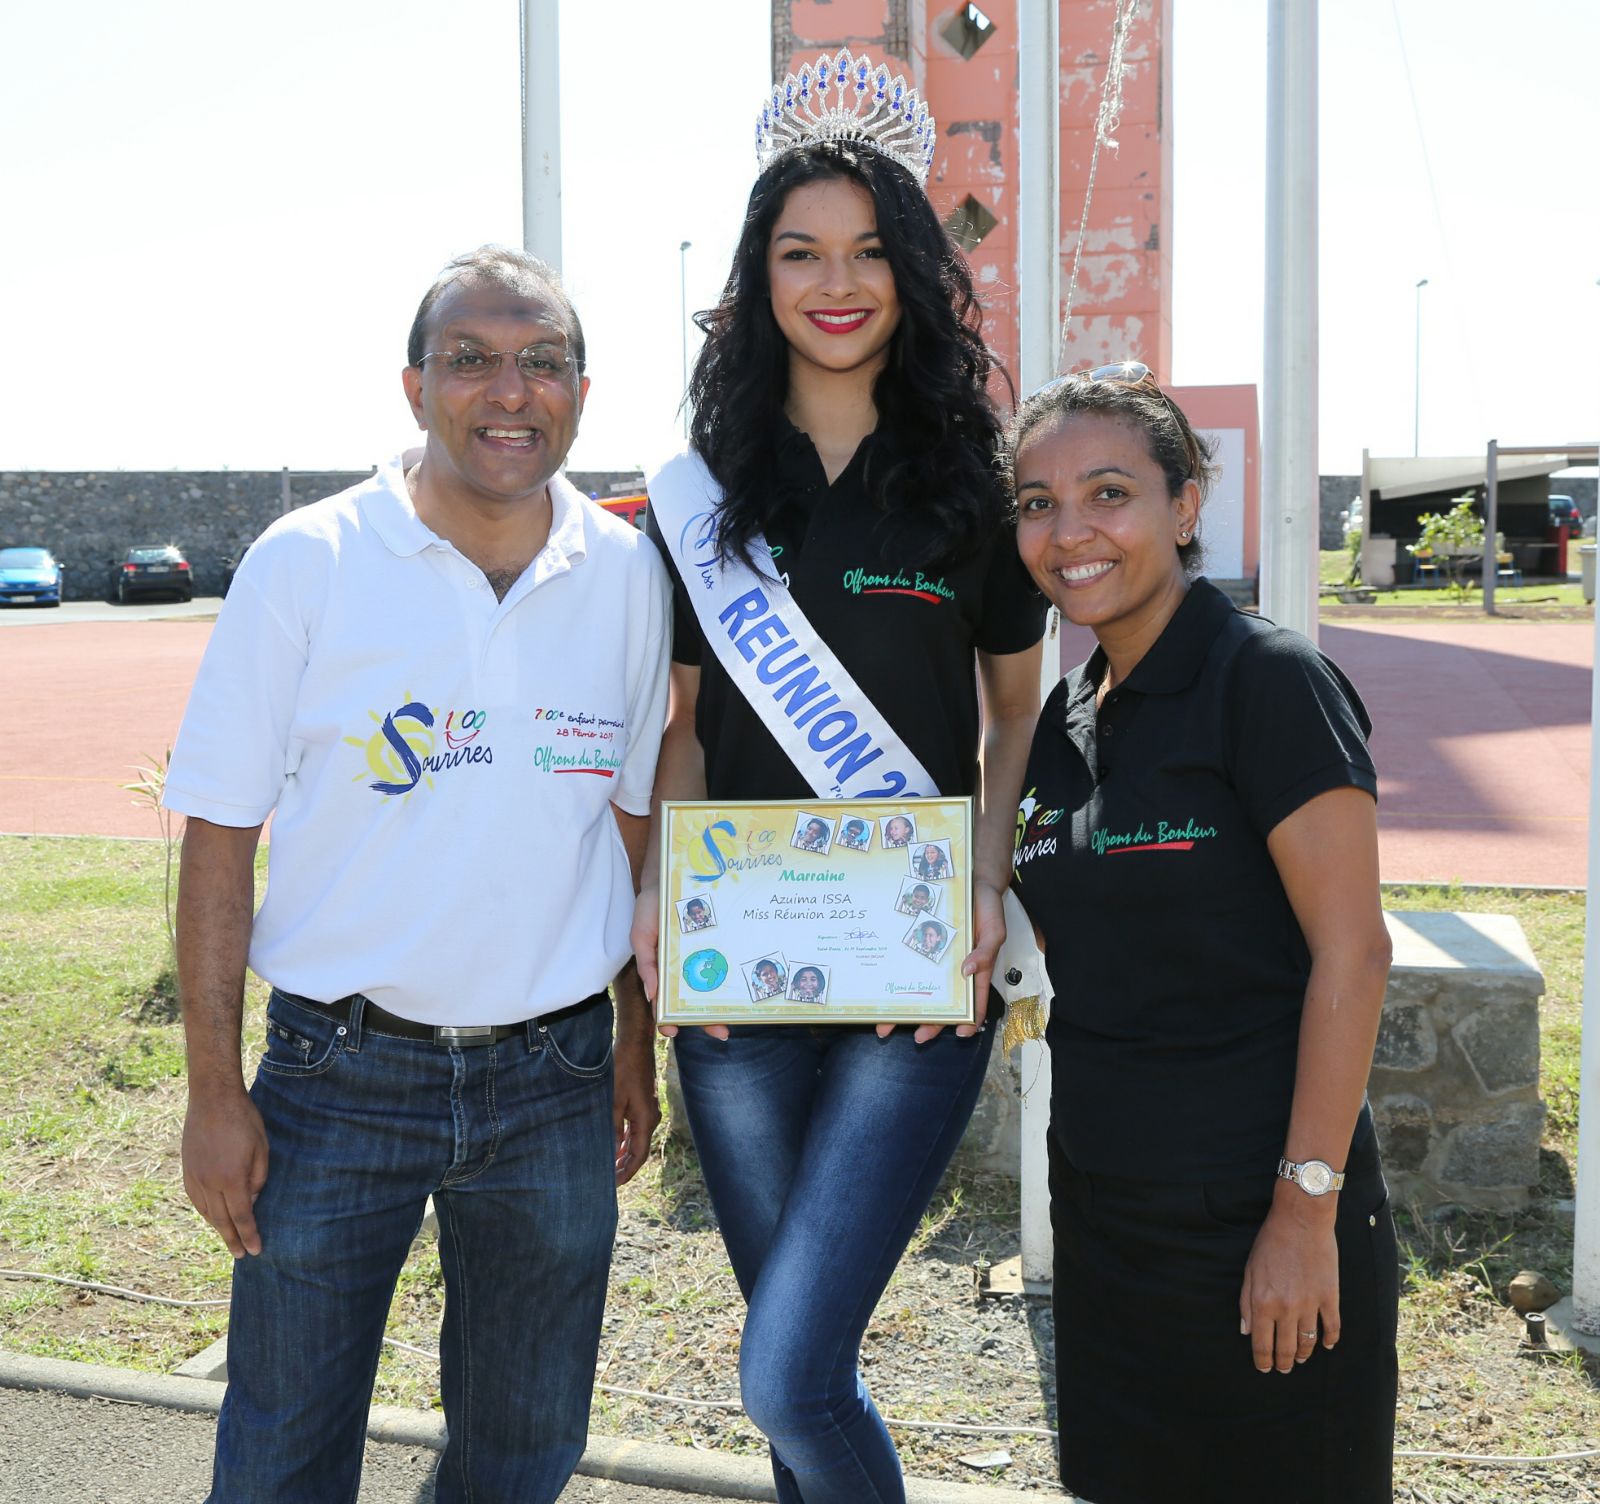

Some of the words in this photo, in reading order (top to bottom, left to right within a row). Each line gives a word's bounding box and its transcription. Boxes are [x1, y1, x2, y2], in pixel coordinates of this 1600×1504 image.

[843, 568, 890, 594] Offrons
[891, 568, 911, 587] du
[914, 572, 955, 601] Bonheur
[718, 587, 884, 785] REUNION
[853, 770, 921, 798] 2
[556, 728, 569, 737] 28
[567, 712, 595, 726] enfant
[368, 702, 492, 795] Sourires
[534, 746, 576, 773] Offrons
[578, 748, 592, 766] du
[1091, 828, 1131, 854] Offrons
[1132, 822, 1153, 843] du
[1156, 818, 1218, 844] Bonheur
[688, 820, 783, 882] Sourires
[778, 869, 845, 882] Marraine
[769, 893, 817, 905] Azuima
[822, 894, 852, 905] ISSA
[743, 909, 769, 920] Miss
[774, 908, 825, 920] Réunion
[829, 909, 867, 919] 2015
